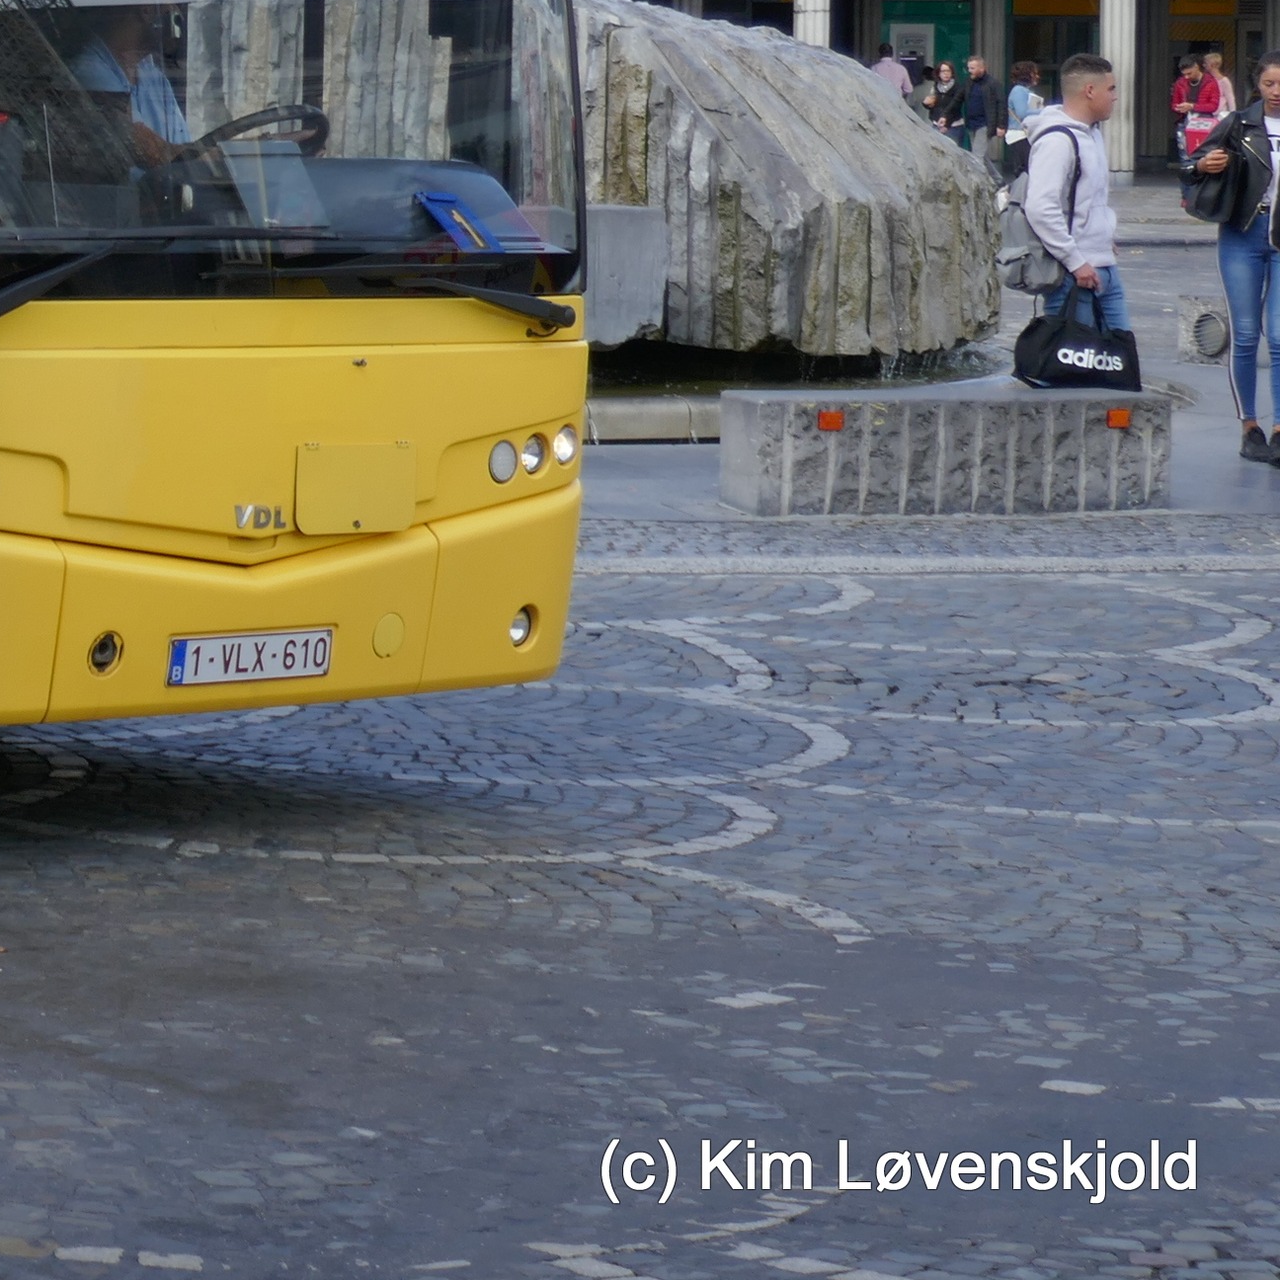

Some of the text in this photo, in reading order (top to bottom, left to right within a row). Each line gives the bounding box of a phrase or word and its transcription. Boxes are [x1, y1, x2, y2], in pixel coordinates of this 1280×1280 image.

[1057, 347, 1124, 372] adidas
[234, 504, 287, 529] VDL
[192, 637, 328, 676] 1-VLX-610
[171, 665, 182, 681] B
